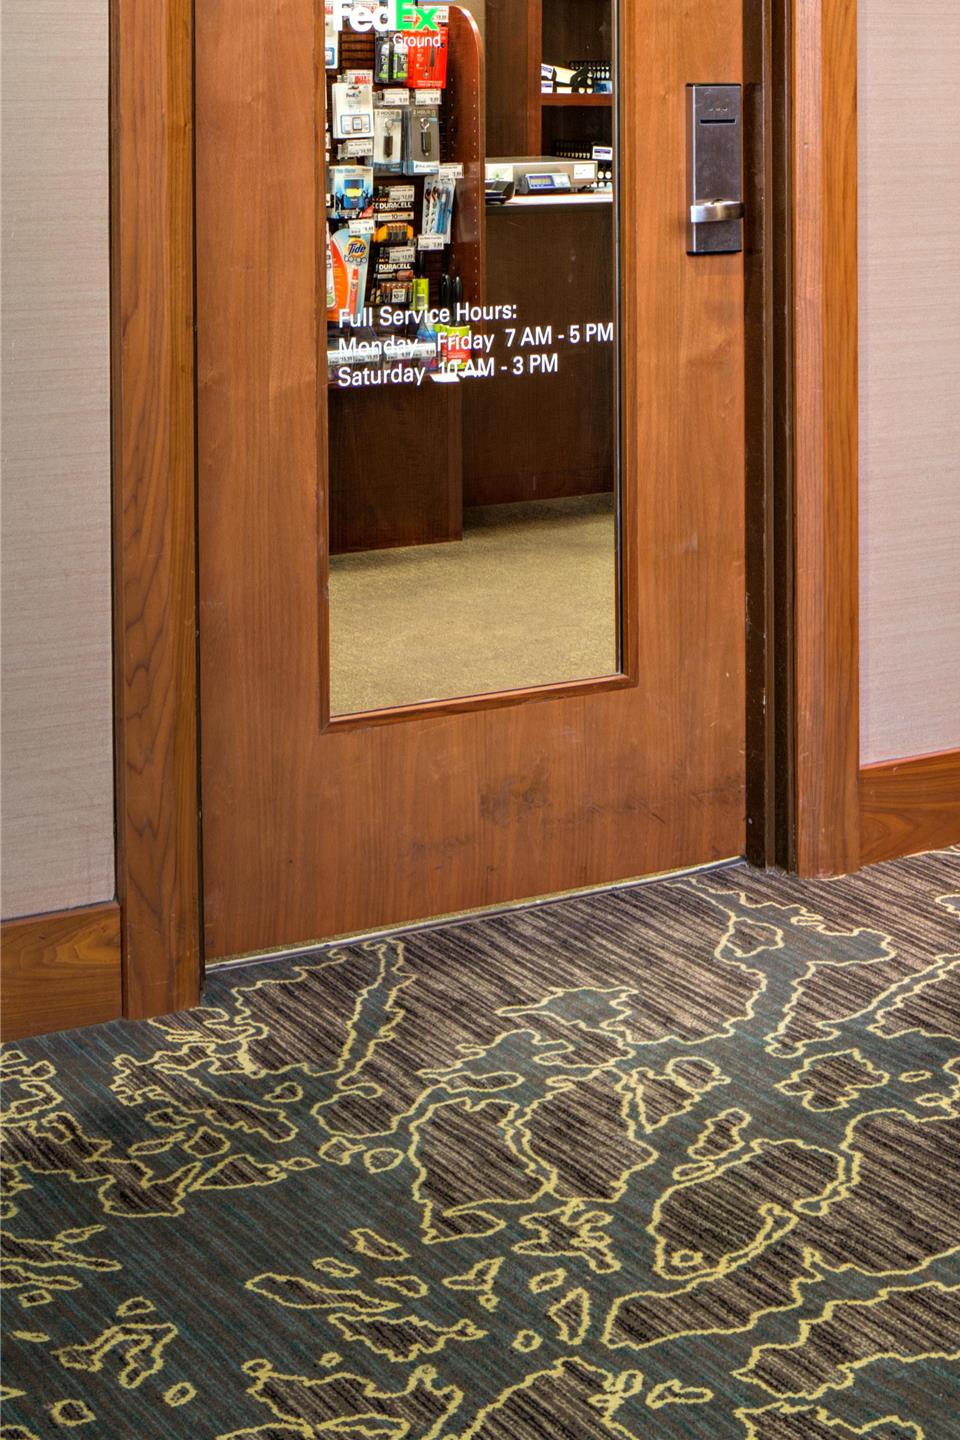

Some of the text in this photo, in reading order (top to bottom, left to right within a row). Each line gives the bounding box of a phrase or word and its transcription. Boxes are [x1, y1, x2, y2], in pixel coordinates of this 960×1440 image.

[393, 33, 441, 48] Ground
[379, 201, 412, 209] DURACELL
[349, 243, 366, 255] Tide
[338, 302, 518, 328] Full Service Hours:
[338, 335, 419, 358] Monday
[436, 330, 494, 353] Friday
[504, 328, 517, 347] 7
[521, 326, 552, 346] AM
[569, 325, 580, 344] 5
[585, 322, 614, 343] PM
[338, 363, 426, 387] Saturday
[438, 360, 459, 378] 10
[463, 358, 495, 377] AM
[512, 356, 524, 375] 3
[528, 353, 559, 374] PM
